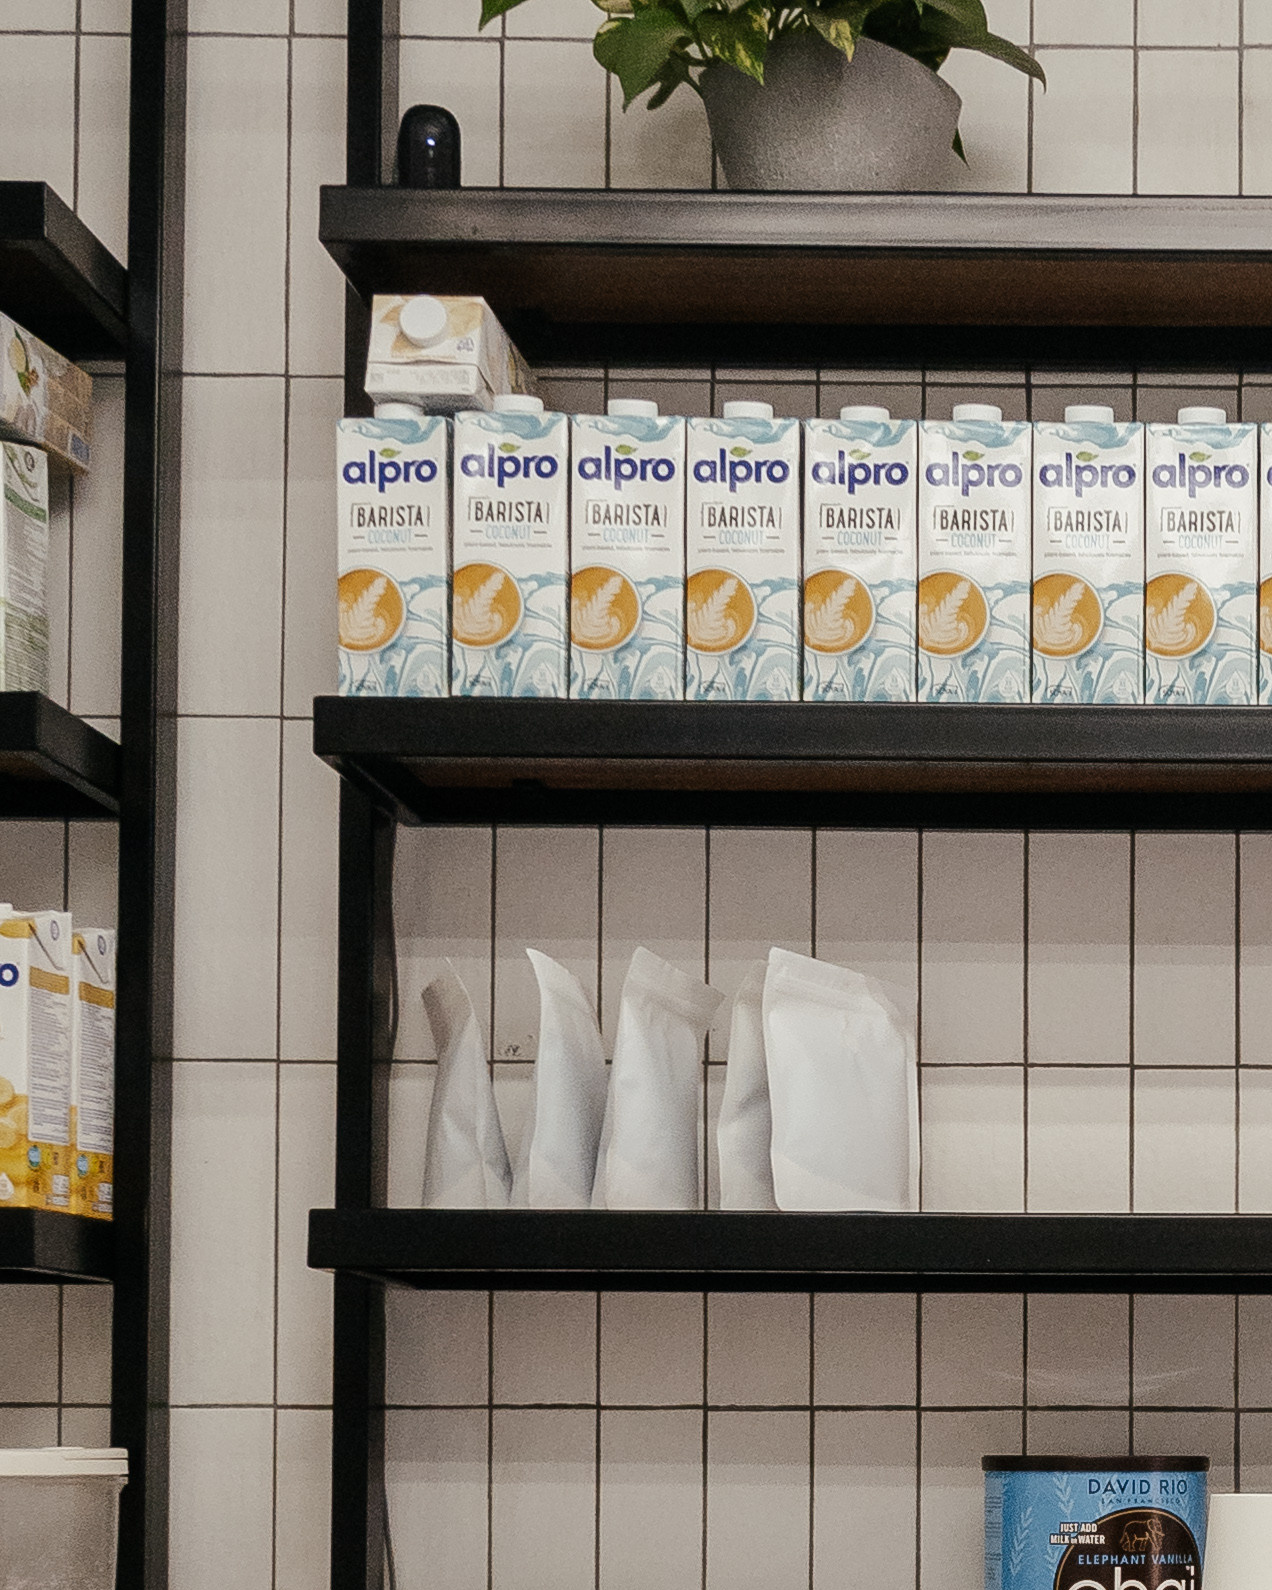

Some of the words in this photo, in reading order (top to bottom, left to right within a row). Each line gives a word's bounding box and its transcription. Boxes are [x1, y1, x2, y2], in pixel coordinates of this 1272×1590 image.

[343, 450, 437, 493] alpro
[461, 443, 558, 488] alpro
[578, 445, 675, 490] alpro
[693, 448, 789, 492] alpro
[812, 450, 908, 495] alpro
[926, 451, 1022, 496] alpro
[1039, 452, 1136, 497] alpro
[1152, 453, 1249, 498] alpro
[357, 505, 423, 527] BARISTA
[475, 502, 543, 523] BARISTA
[592, 504, 661, 525] BARISTA
[708, 506, 775, 528] BARISTA
[827, 508, 894, 529] BARISTA
[940, 509, 1007, 530] BARISTA
[1054, 510, 1122, 532] BARISTA
[1167, 511, 1235, 533] BARISTA
[368, 529, 412, 543] COCONUT
[486, 525, 532, 539] COCONUT
[603, 528, 649, 543] COCONUT
[719, 531, 764, 544] COCONUT
[837, 531, 882, 545] COCONUT
[951, 534, 996, 547] COCONUT
[1065, 535, 1110, 549] COCONUT
[1178, 535, 1223, 549] COCONUT
[1088, 1479, 1151, 1494] DAVID
[1160, 1479, 1188, 1494] RIO
[1060, 1523, 1079, 1533] JUST
[1080, 1523, 1098, 1533] ADD
[1050, 1534, 1070, 1544] MILK
[1078, 1534, 1106, 1544] WATER
[1078, 1554, 1147, 1566] ELEPHANT
[1151, 1554, 1193, 1566] VANILLA
